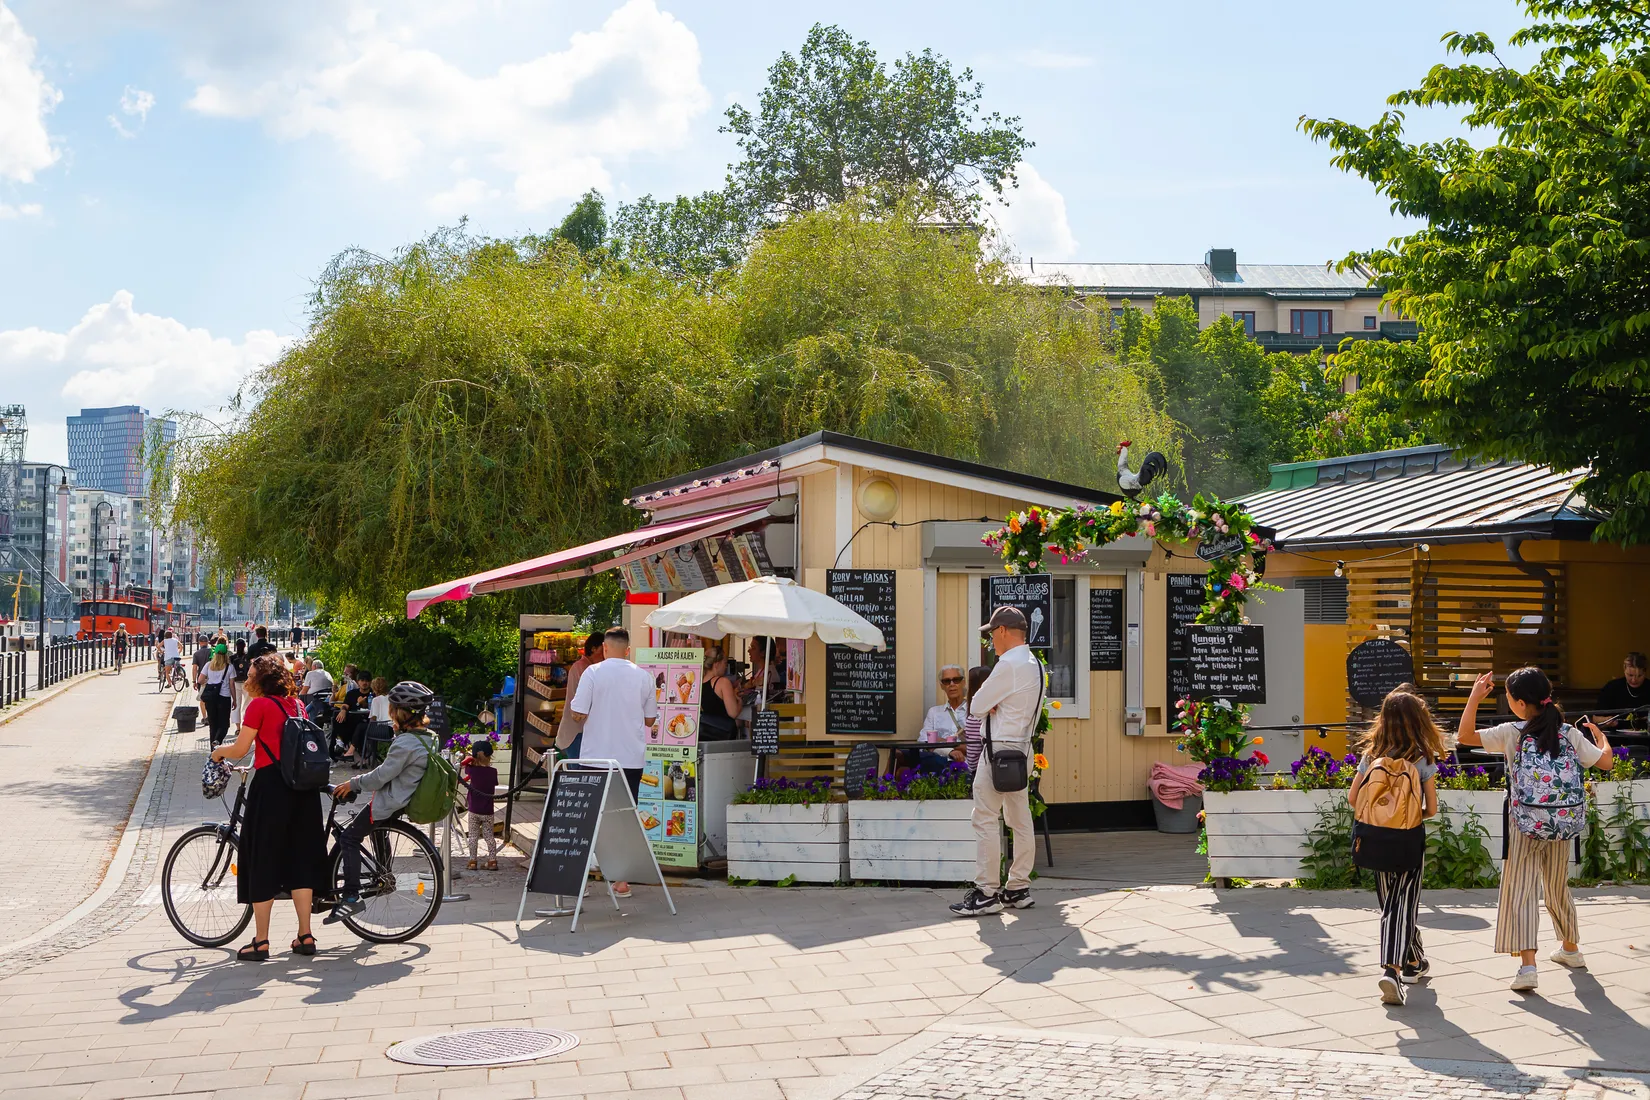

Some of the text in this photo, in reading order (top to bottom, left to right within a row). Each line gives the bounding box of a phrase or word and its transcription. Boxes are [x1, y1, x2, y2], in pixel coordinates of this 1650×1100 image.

[863, 573, 889, 582] KAJSAS
[995, 582, 1048, 595] KULGLASS
[1191, 634, 1225, 645] Hungrig
[674, 650, 679, 659] PÅ
[850, 671, 888, 679] MARRAKESH
